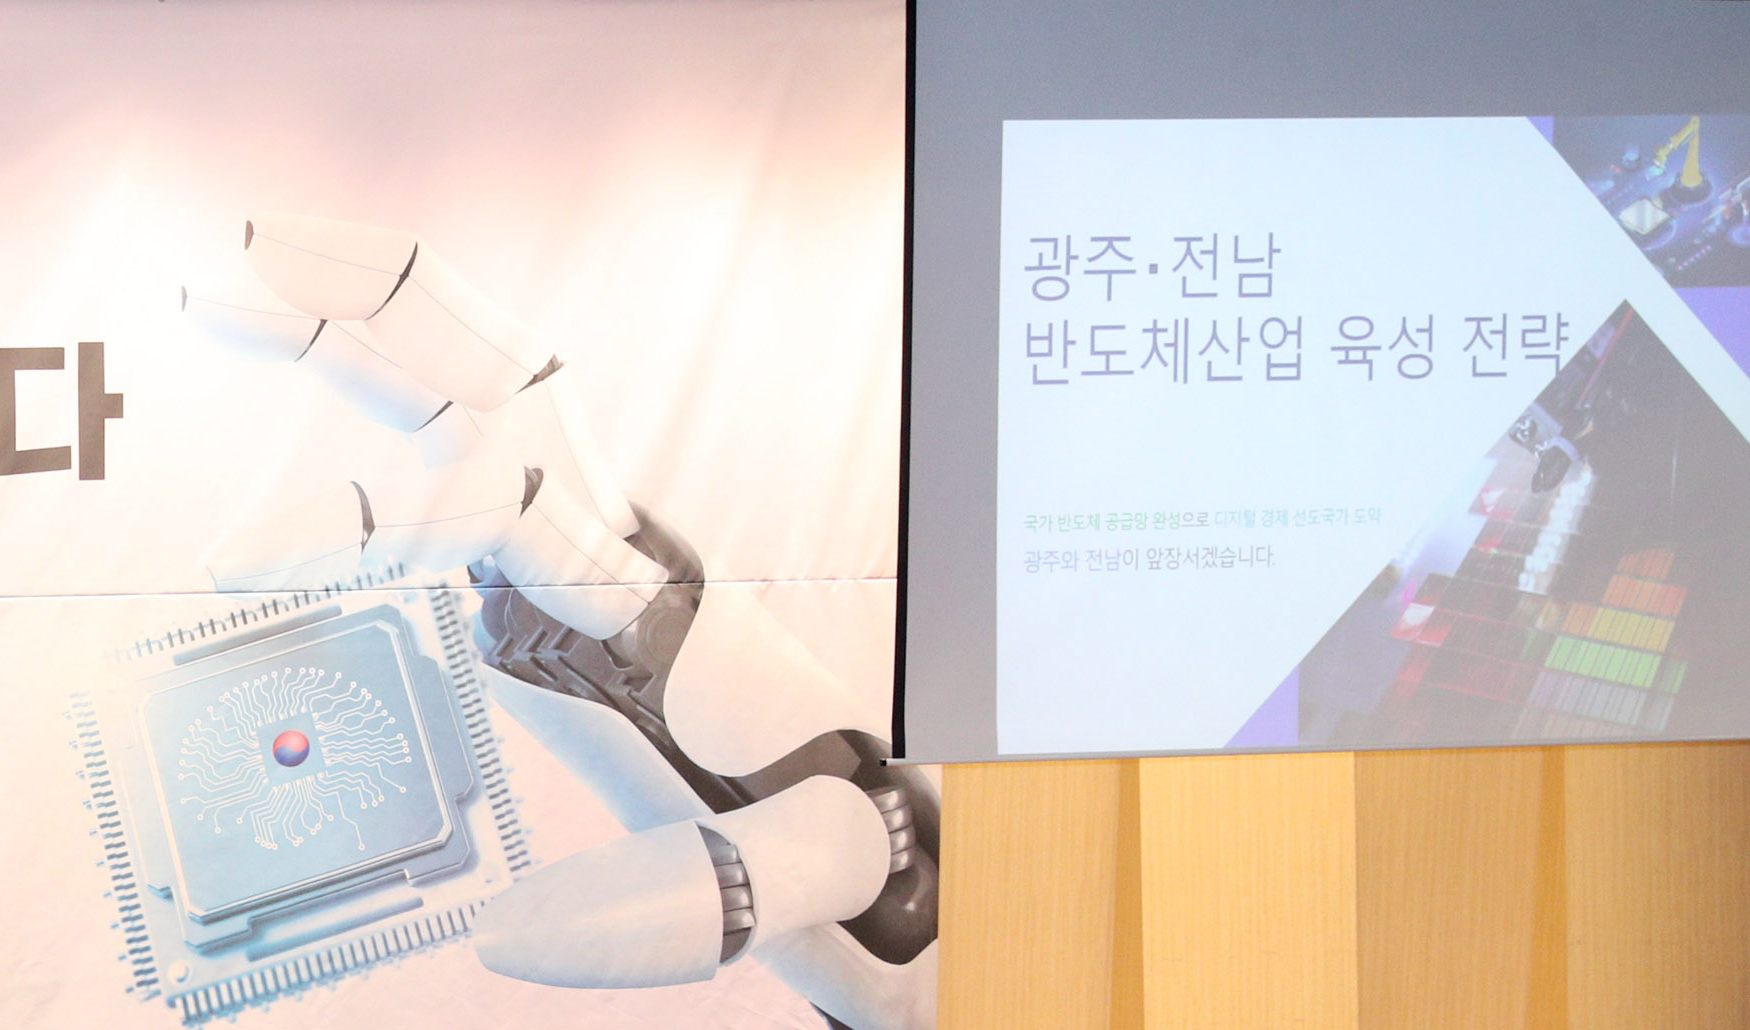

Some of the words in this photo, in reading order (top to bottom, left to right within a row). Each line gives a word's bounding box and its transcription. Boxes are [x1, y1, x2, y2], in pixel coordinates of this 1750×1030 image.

[1023, 231, 1282, 301] 광주·전남
[1024, 314, 1304, 386] 반도체산업
[1330, 312, 1436, 382] 육성
[1461, 311, 1570, 379] 전략
[1023, 514, 1053, 533] 국가
[1057, 513, 1101, 533] 반도체
[1105, 512, 1149, 532] 공급망
[1152, 511, 1210, 531] 완성으로
[1214, 509, 1257, 529] 디지털
[1261, 508, 1289, 528] 경제
[1292, 507, 1349, 527] 선도국가
[1353, 506, 1382, 526] 도약
[1023, 549, 1080, 574] 광주와
[1085, 548, 1139, 573] 전남이
[1146, 546, 1277, 571] 앞장서겠습니다.
